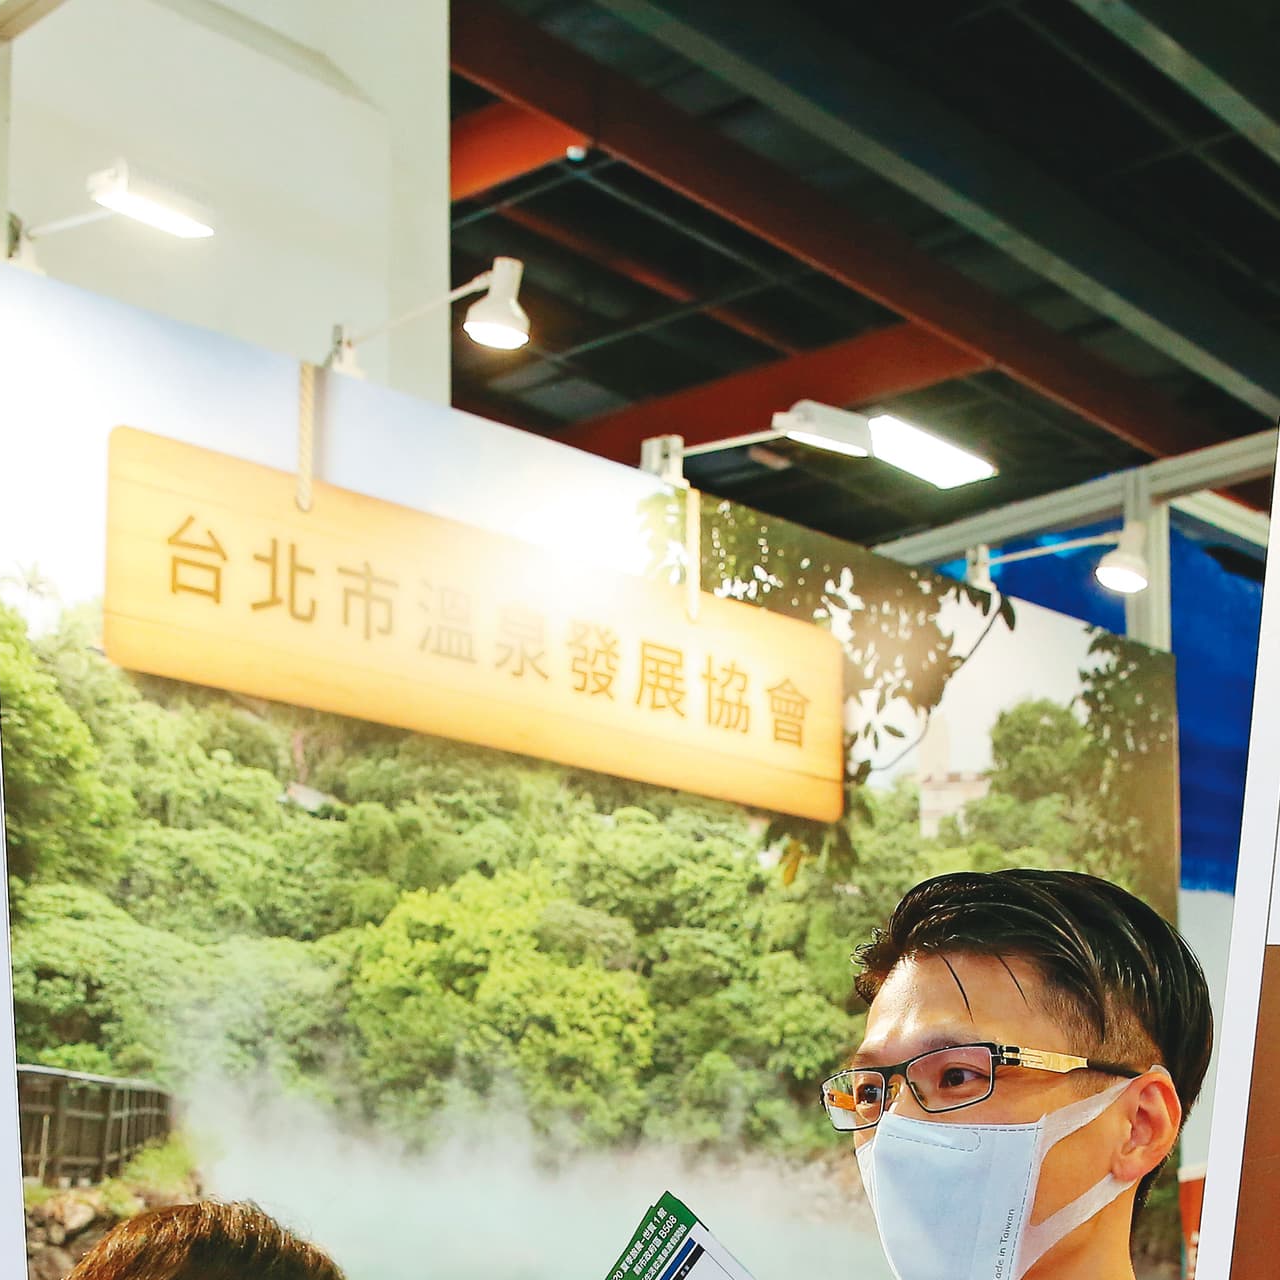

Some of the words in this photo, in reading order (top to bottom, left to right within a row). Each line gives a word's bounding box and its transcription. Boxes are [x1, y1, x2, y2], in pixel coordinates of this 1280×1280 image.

[166, 515, 812, 748] 台北市溫泉發展協會
[1000, 1208, 1015, 1245] Taiwan
